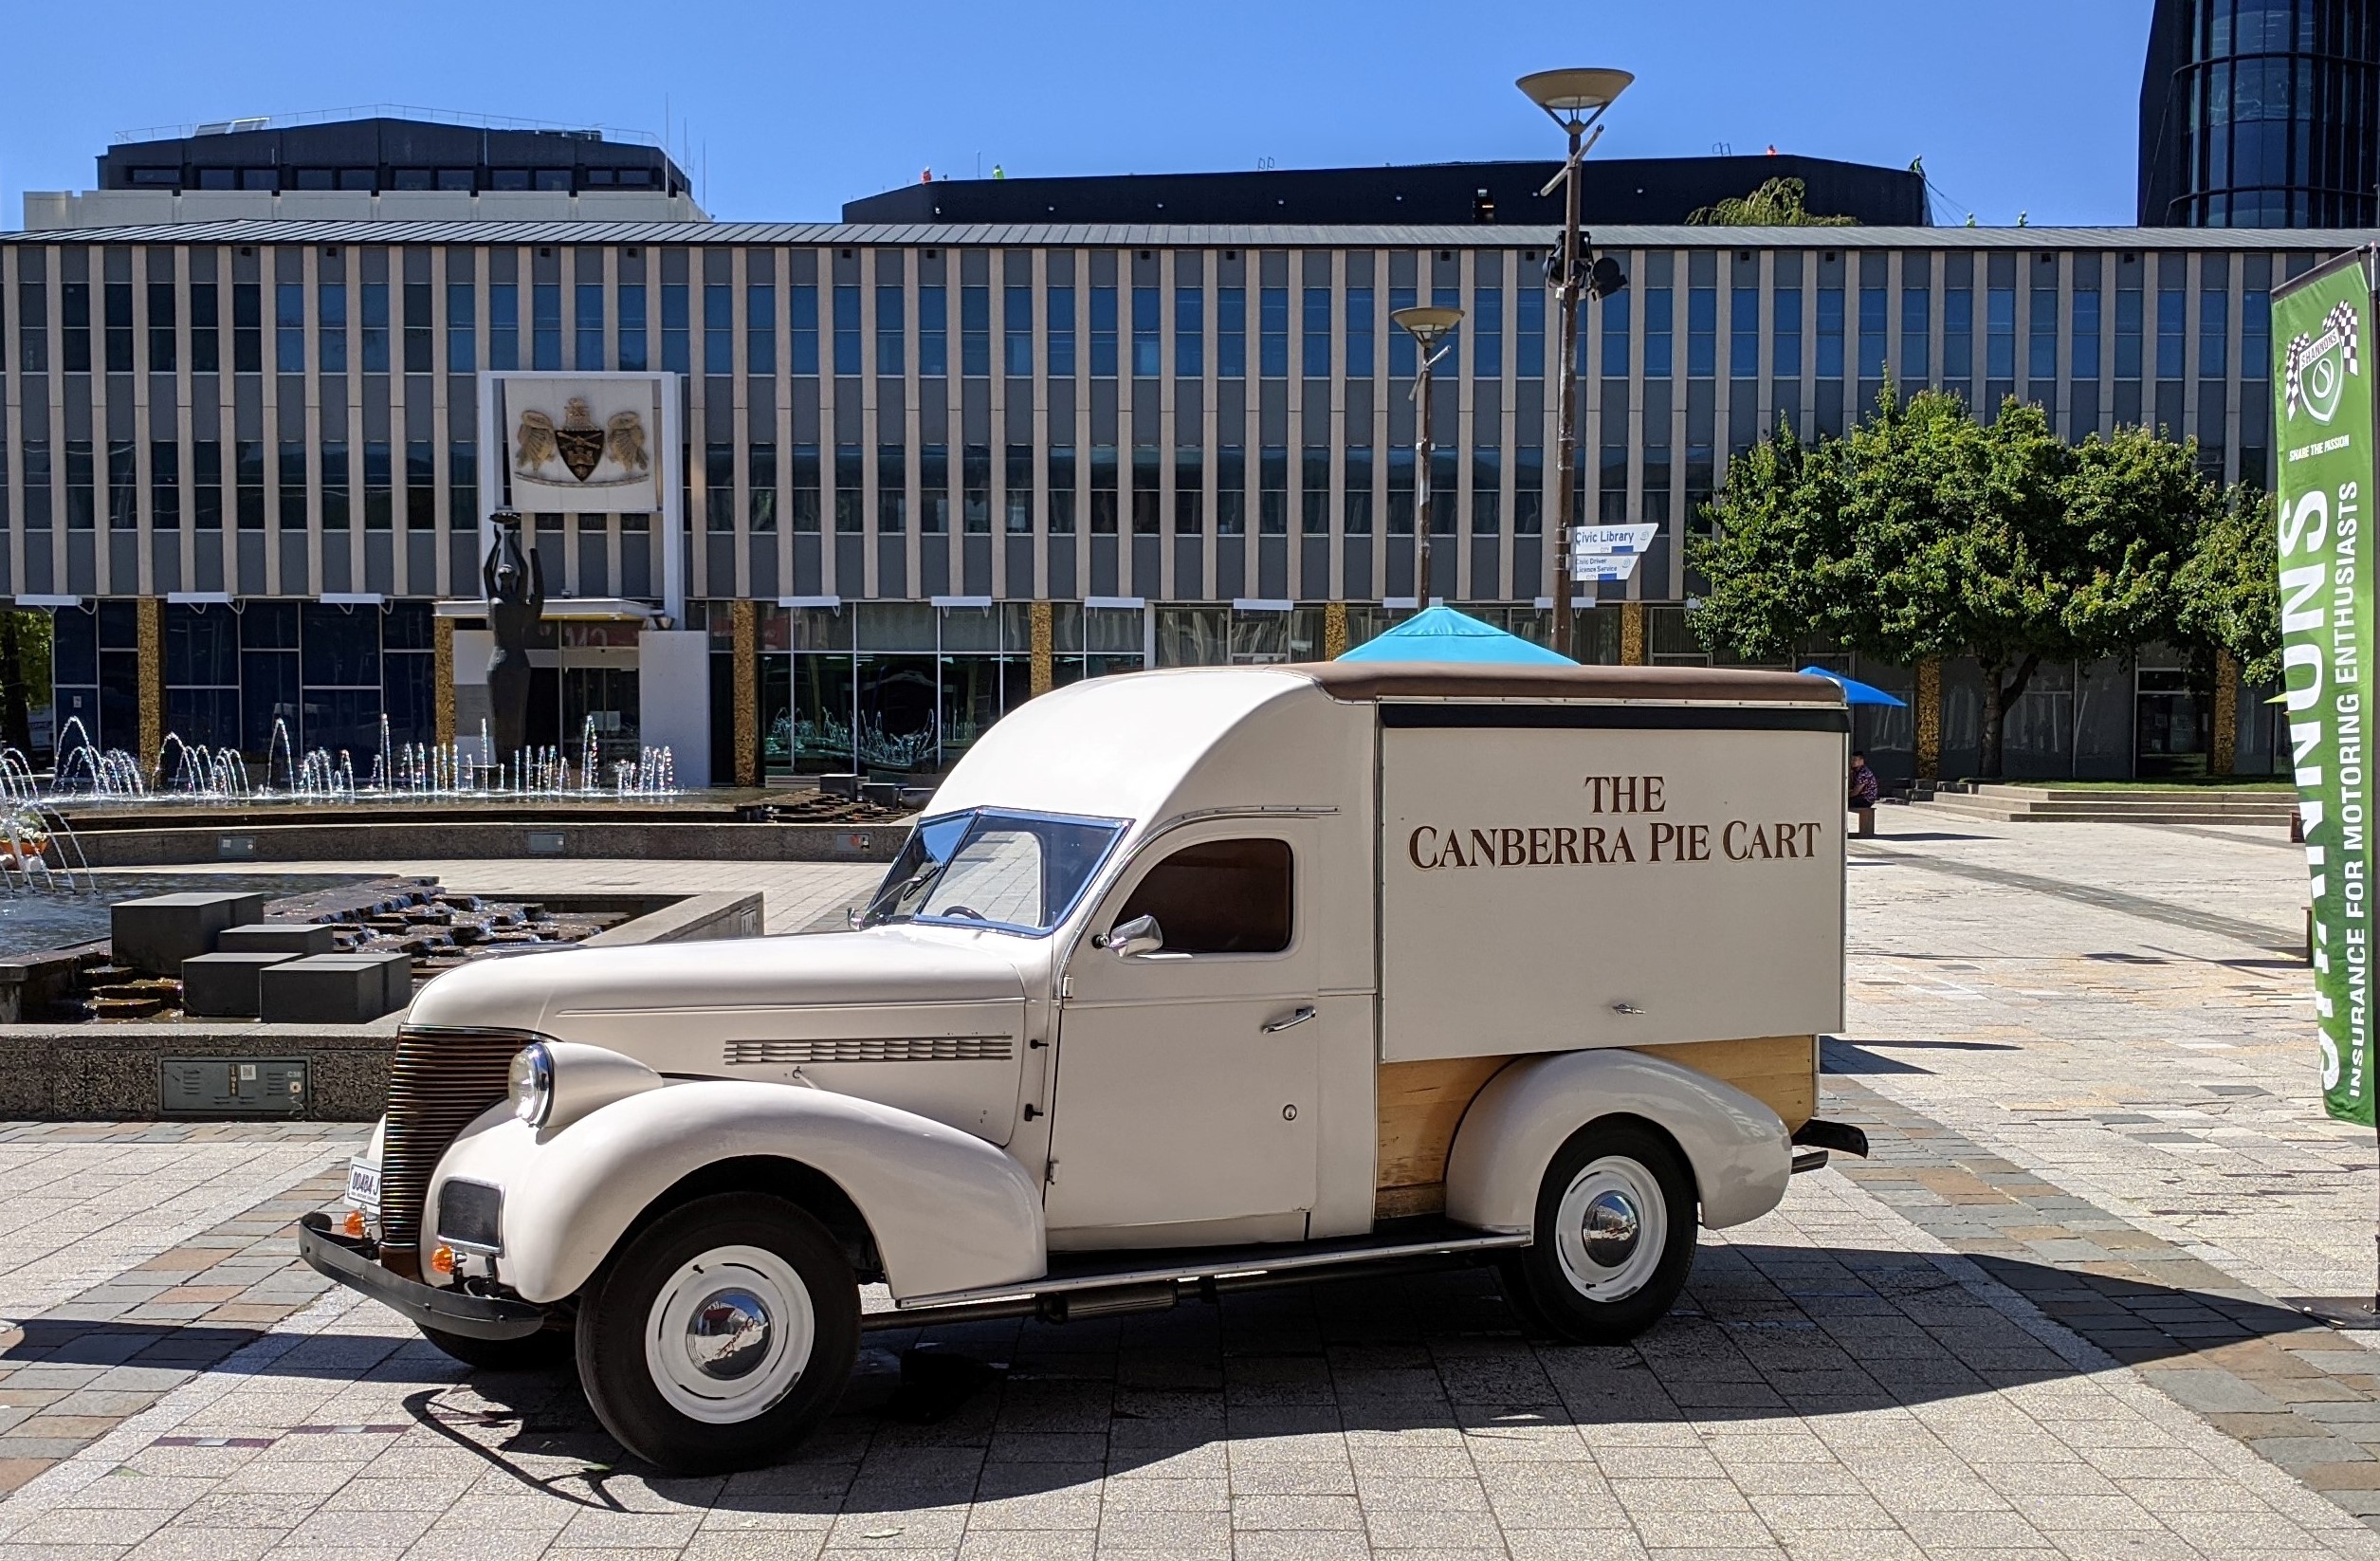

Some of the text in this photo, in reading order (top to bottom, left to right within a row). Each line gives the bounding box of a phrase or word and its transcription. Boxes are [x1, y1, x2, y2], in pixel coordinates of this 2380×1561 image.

[2301, 335, 2337, 367] SHANNONS
[2289, 446, 2310, 462] SHARE
[2310, 442, 2324, 456] THE
[1576, 530, 1635, 544] Civic Library
[1584, 776, 1666, 813] THE
[2334, 481, 2366, 1097] INSURANCE FOR MOTORING ENTHUSIASTS
[1408, 820, 1822, 869] CANBERRA PIE CART
